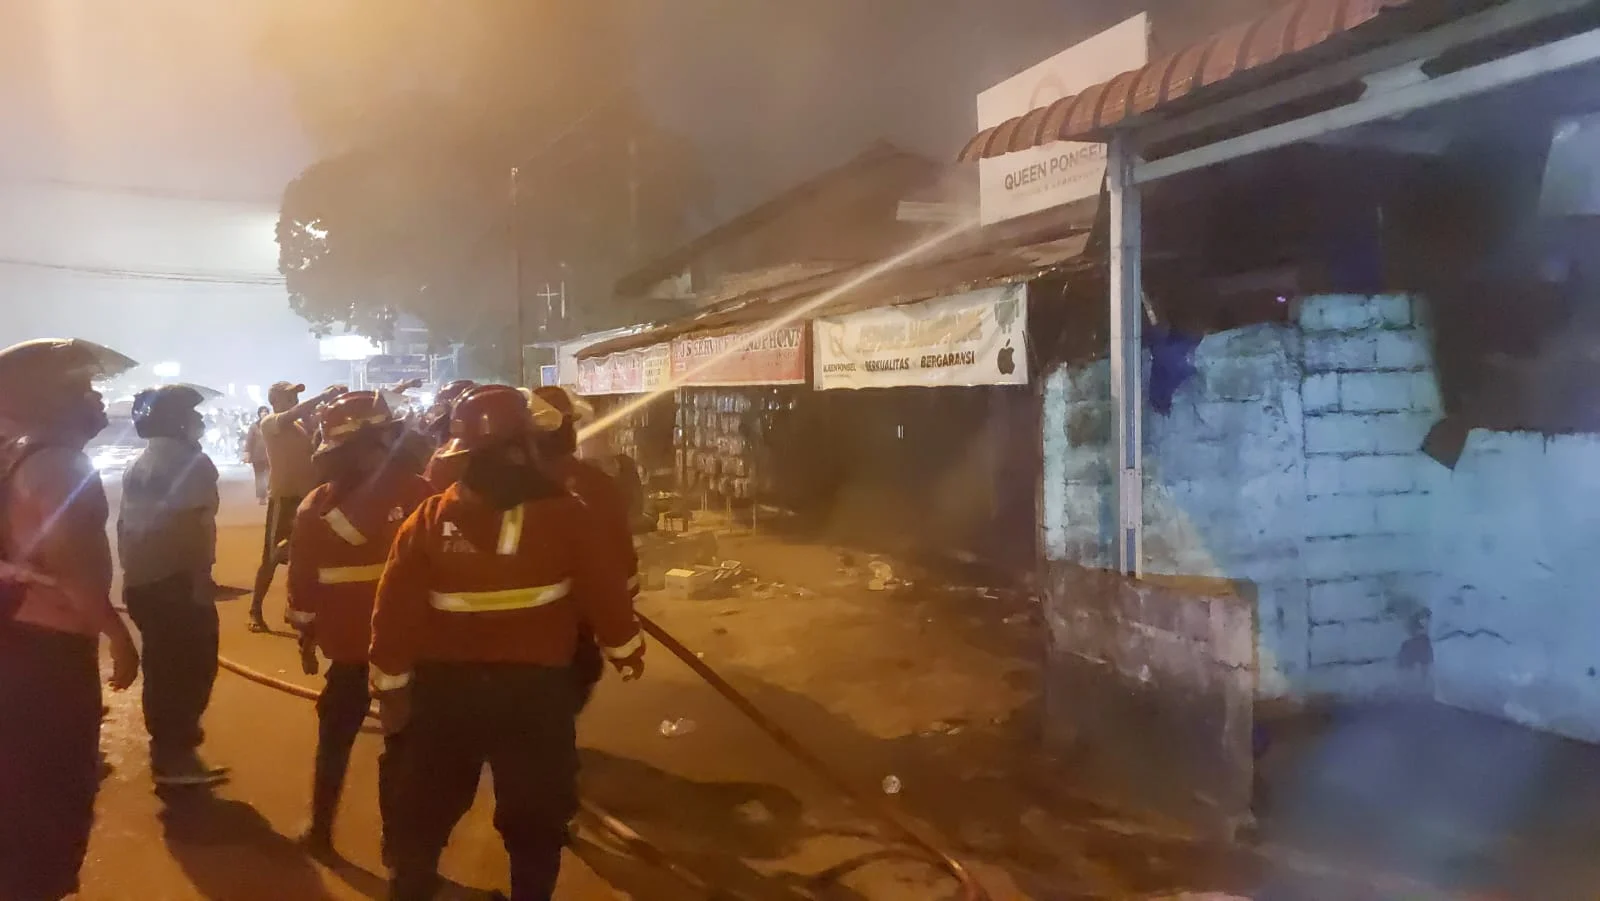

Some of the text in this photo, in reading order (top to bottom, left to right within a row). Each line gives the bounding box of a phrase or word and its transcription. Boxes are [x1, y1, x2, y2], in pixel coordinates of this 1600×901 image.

[1004, 161, 1047, 190] QUEEN
[1049, 143, 1106, 174] PONSEL
[733, 328, 802, 355] NDPHONE
[920, 350, 975, 369] BERGARANSI
